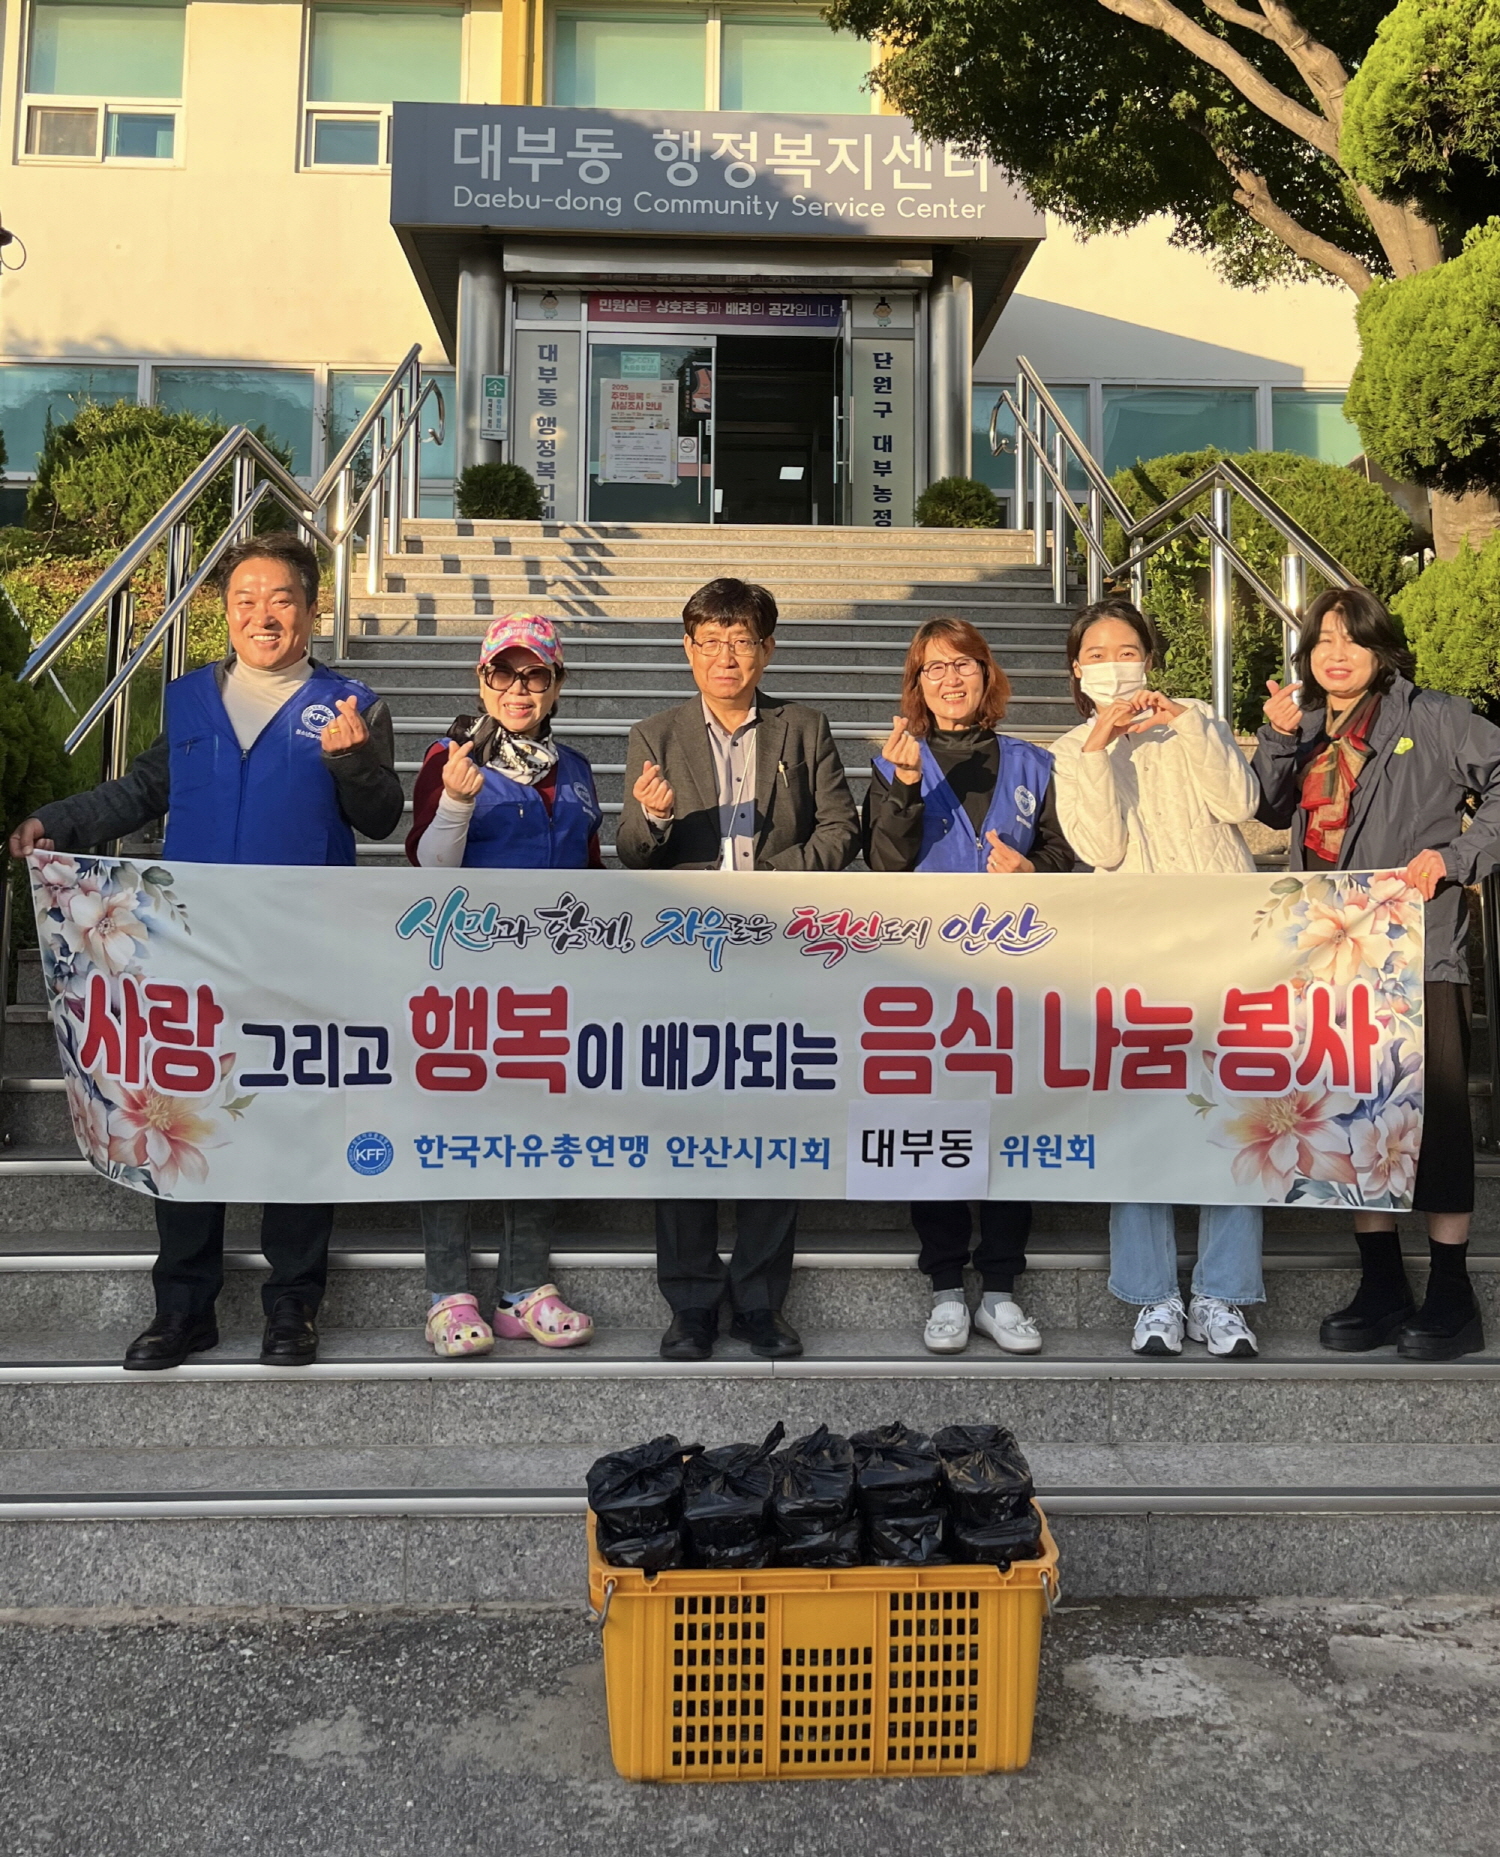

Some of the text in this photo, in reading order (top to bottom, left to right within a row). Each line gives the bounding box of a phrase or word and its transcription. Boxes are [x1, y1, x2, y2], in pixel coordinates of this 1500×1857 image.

[454, 124, 988, 192] 대부동 행정복지센터
[454, 186, 986, 220] Daebu-dong Community Service Center
[599, 299, 837, 318] 민원실은 상호존중과 배려의 공간입니다.
[537, 344, 558, 407] 대부동
[872, 352, 893, 528] 단원구 대부농정
[396, 886, 541, 970] 시민과
[642, 906, 776, 972] 자유로운
[784, 906, 932, 969] 혁신도시
[939, 902, 1057, 955] 안산
[80, 974, 1380, 1095] 사랑 그리고 행복이 배가되는 음식 나눔 봉사
[356, 1148, 386, 1161] KFF
[414, 1129, 1096, 1170] 한국자유총연맹 안산시지회 대부동 위원회
